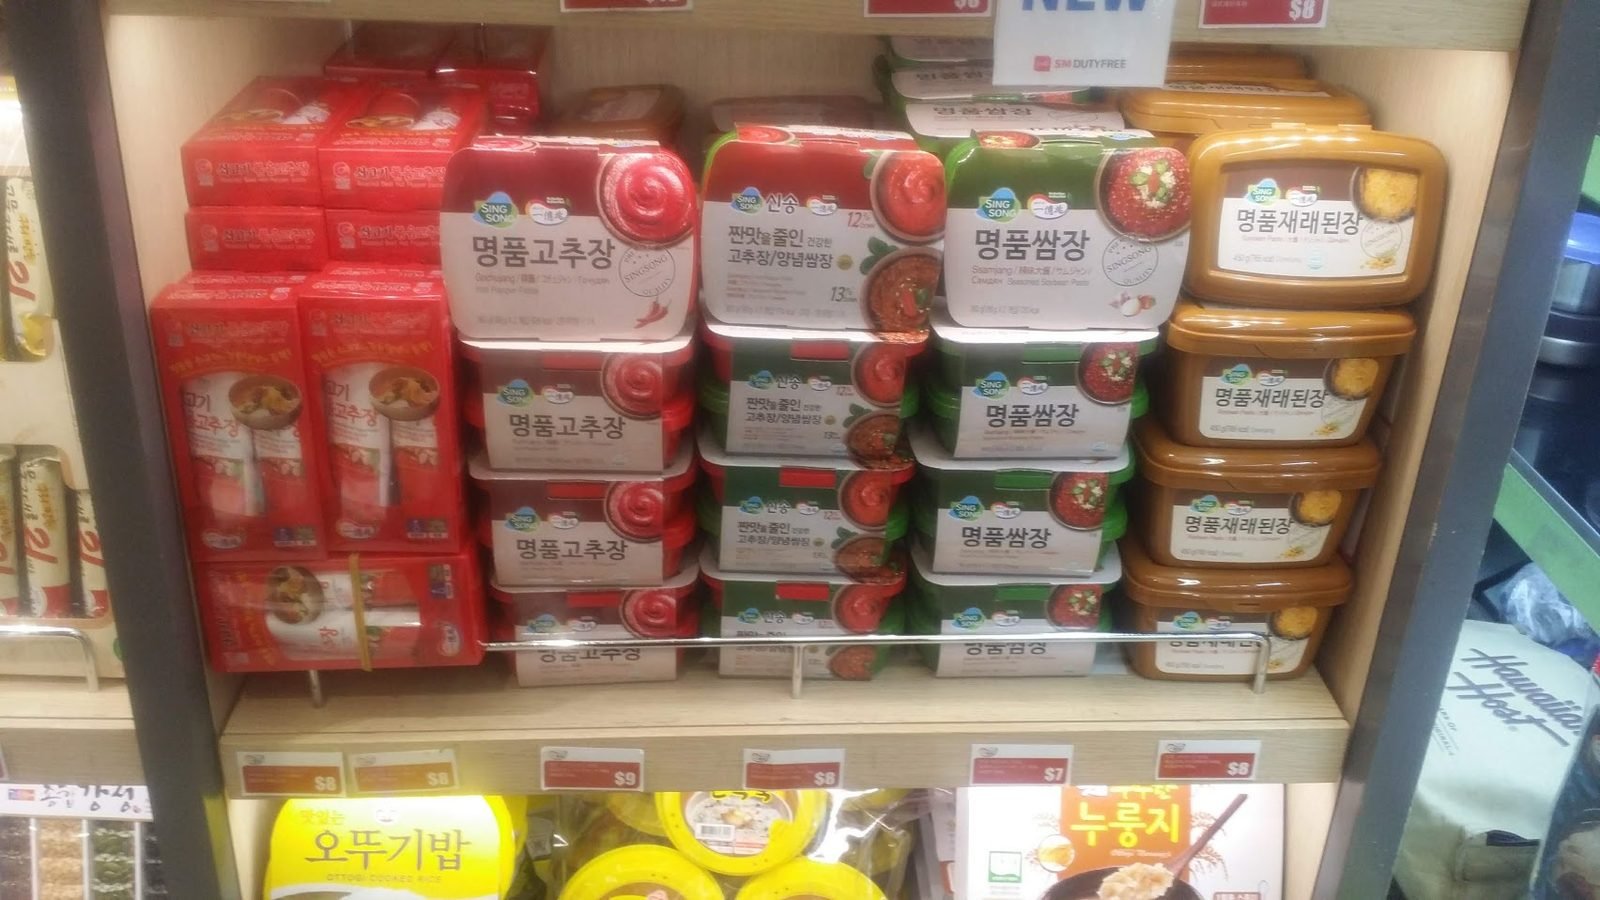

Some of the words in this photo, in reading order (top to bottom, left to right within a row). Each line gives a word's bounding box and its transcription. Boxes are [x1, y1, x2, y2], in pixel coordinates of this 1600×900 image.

[481, 203, 508, 214] SING
[766, 193, 799, 214] 신송
[985, 199, 1011, 210] SING
[987, 208, 1017, 218] SONG
[1237, 209, 1363, 236] 명품재래된장
[472, 236, 616, 270] 명품고추장
[976, 228, 1091, 262] 명품쌈장
[1215, 388, 1328, 408] 명품재래된장
[986, 403, 1079, 428] 명품쌈장
[509, 413, 626, 440] 명품고추장
[1185, 516, 1293, 535] 명품재래된장
[962, 526, 1051, 549] 명품쌈장
[517, 539, 628, 561] 명품고추장
[1446, 672, 1570, 748] Host
[427, 772, 449, 787] $8
[615, 771, 637, 787] $9
[814, 772, 835, 786] $8
[1044, 768, 1063, 782] $7
[1227, 762, 1250, 777] $8
[314, 776, 338, 791] $8
[1070, 801, 1180, 848] 누룽지
[304, 828, 472, 871] 오뚜기밥
